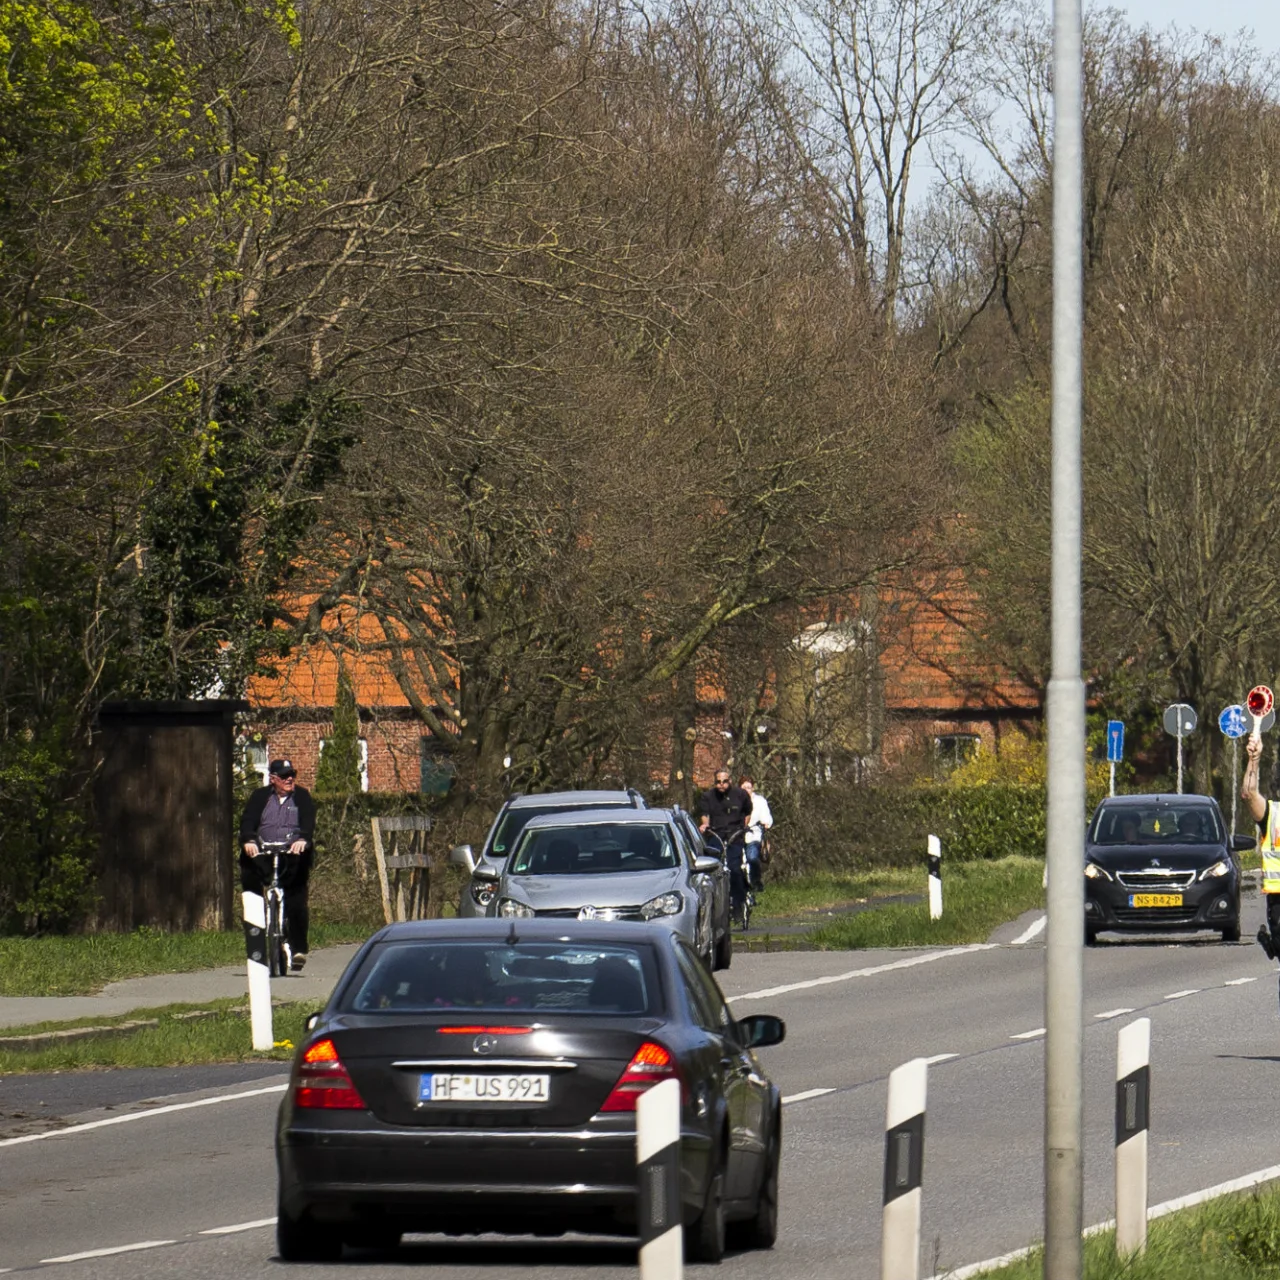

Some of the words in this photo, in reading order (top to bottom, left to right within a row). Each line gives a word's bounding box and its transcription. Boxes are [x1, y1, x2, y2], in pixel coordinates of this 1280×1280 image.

[434, 1077, 460, 1097] HF
[475, 1077, 502, 1097] US
[507, 1077, 545, 1098] 991
